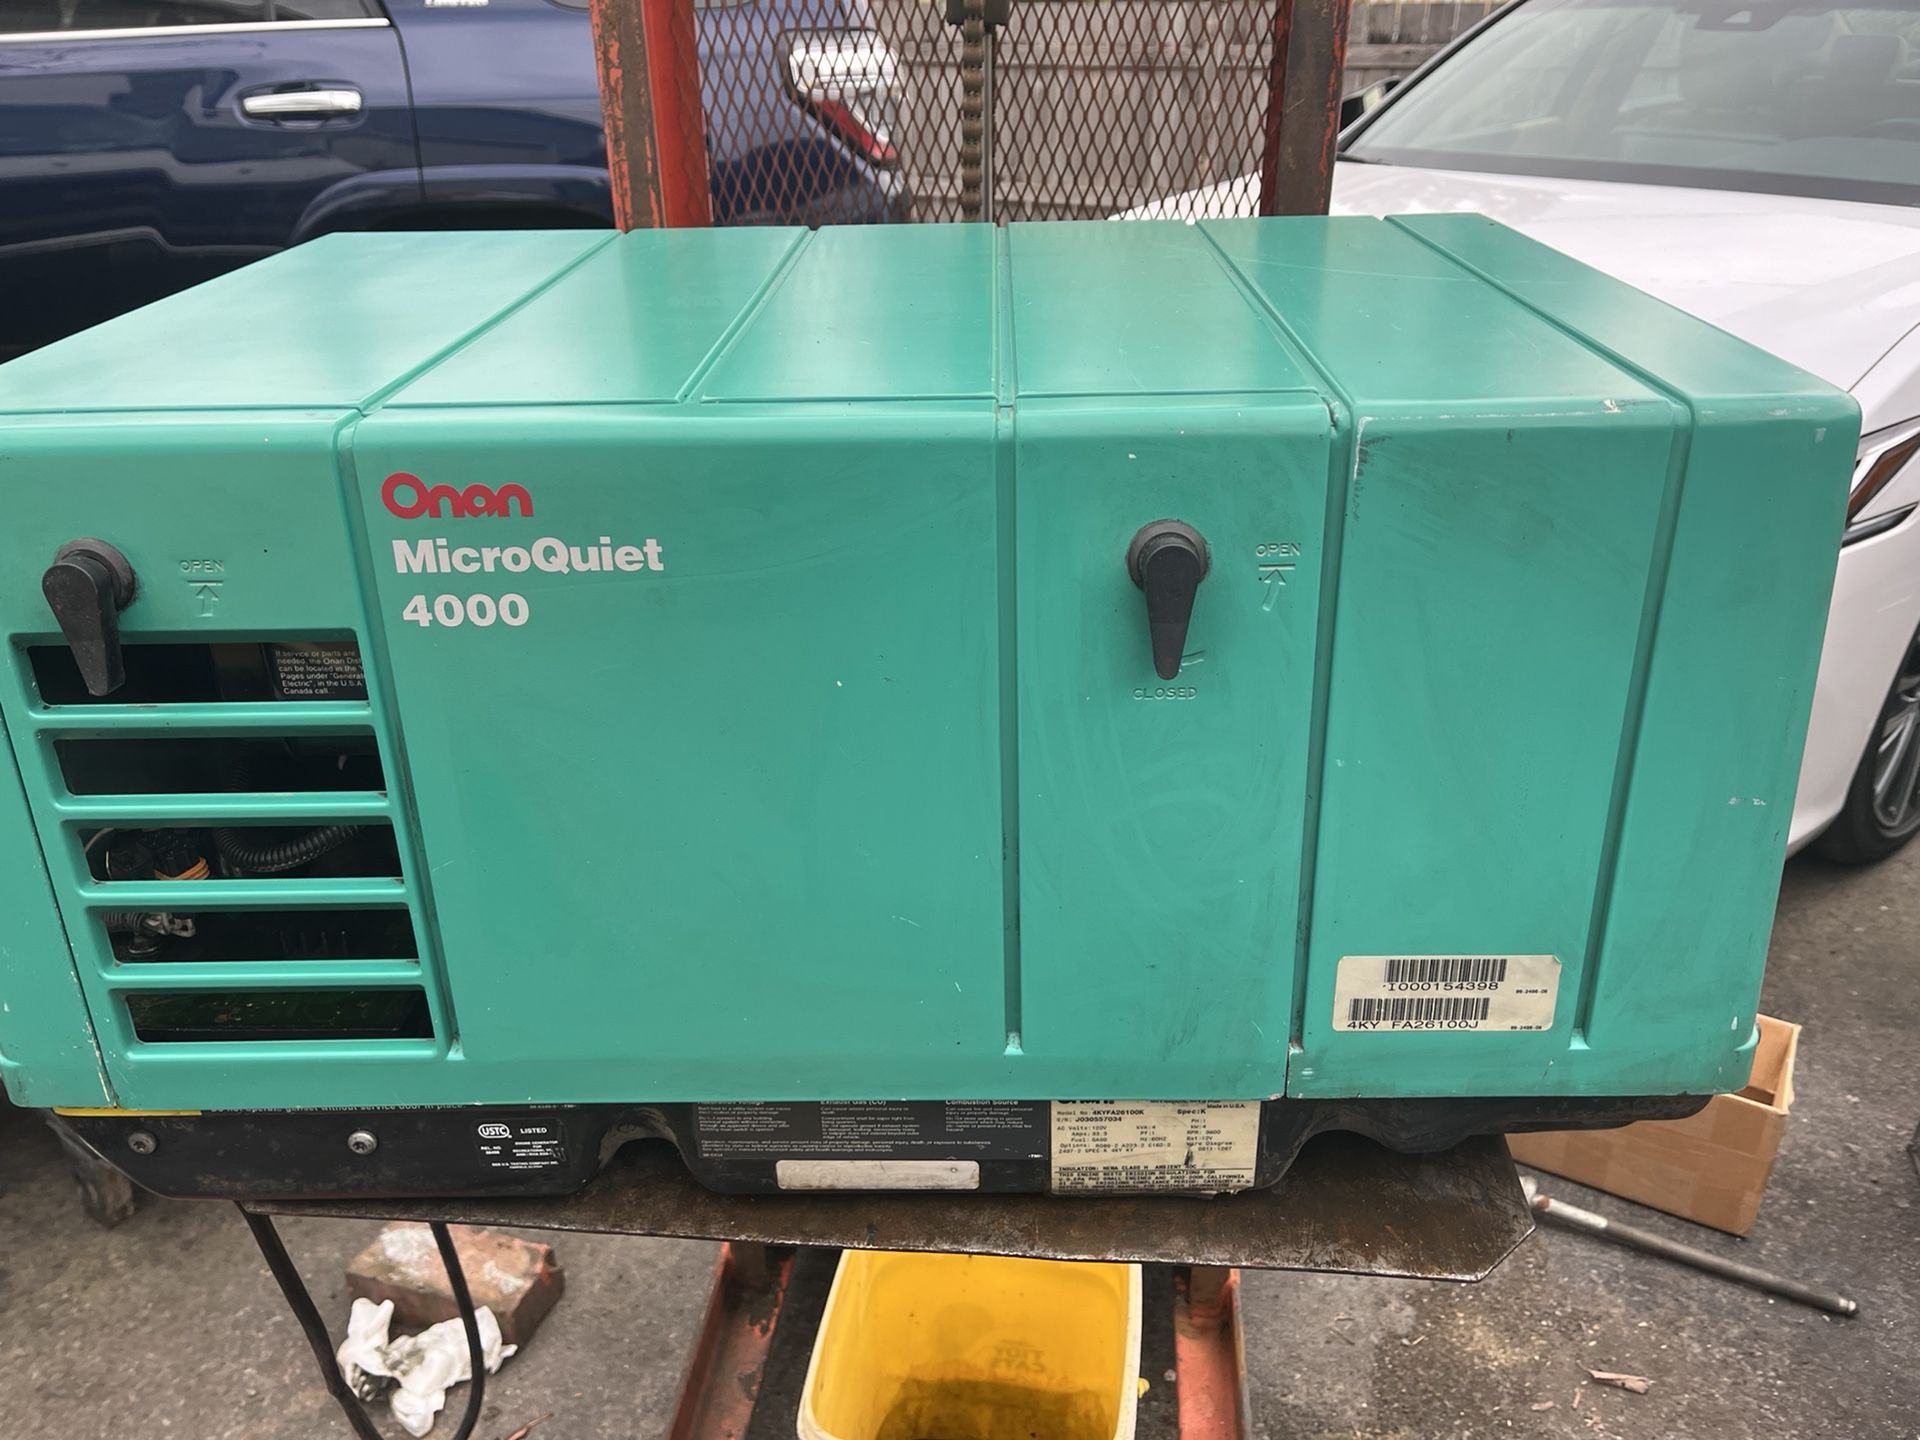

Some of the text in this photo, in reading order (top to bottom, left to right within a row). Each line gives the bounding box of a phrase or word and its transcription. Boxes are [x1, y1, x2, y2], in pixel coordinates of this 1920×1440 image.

[381, 471, 534, 519] Onan
[392, 536, 664, 574] MicroQuiet
[1255, 543, 1301, 557] OPEN
[179, 560, 224, 572] OPEN
[402, 593, 530, 627] 4000
[1133, 687, 1198, 700] CLOSED
[1347, 1020, 1478, 1030] 4KY FA26100J
[482, 1127, 506, 1135] USTC
